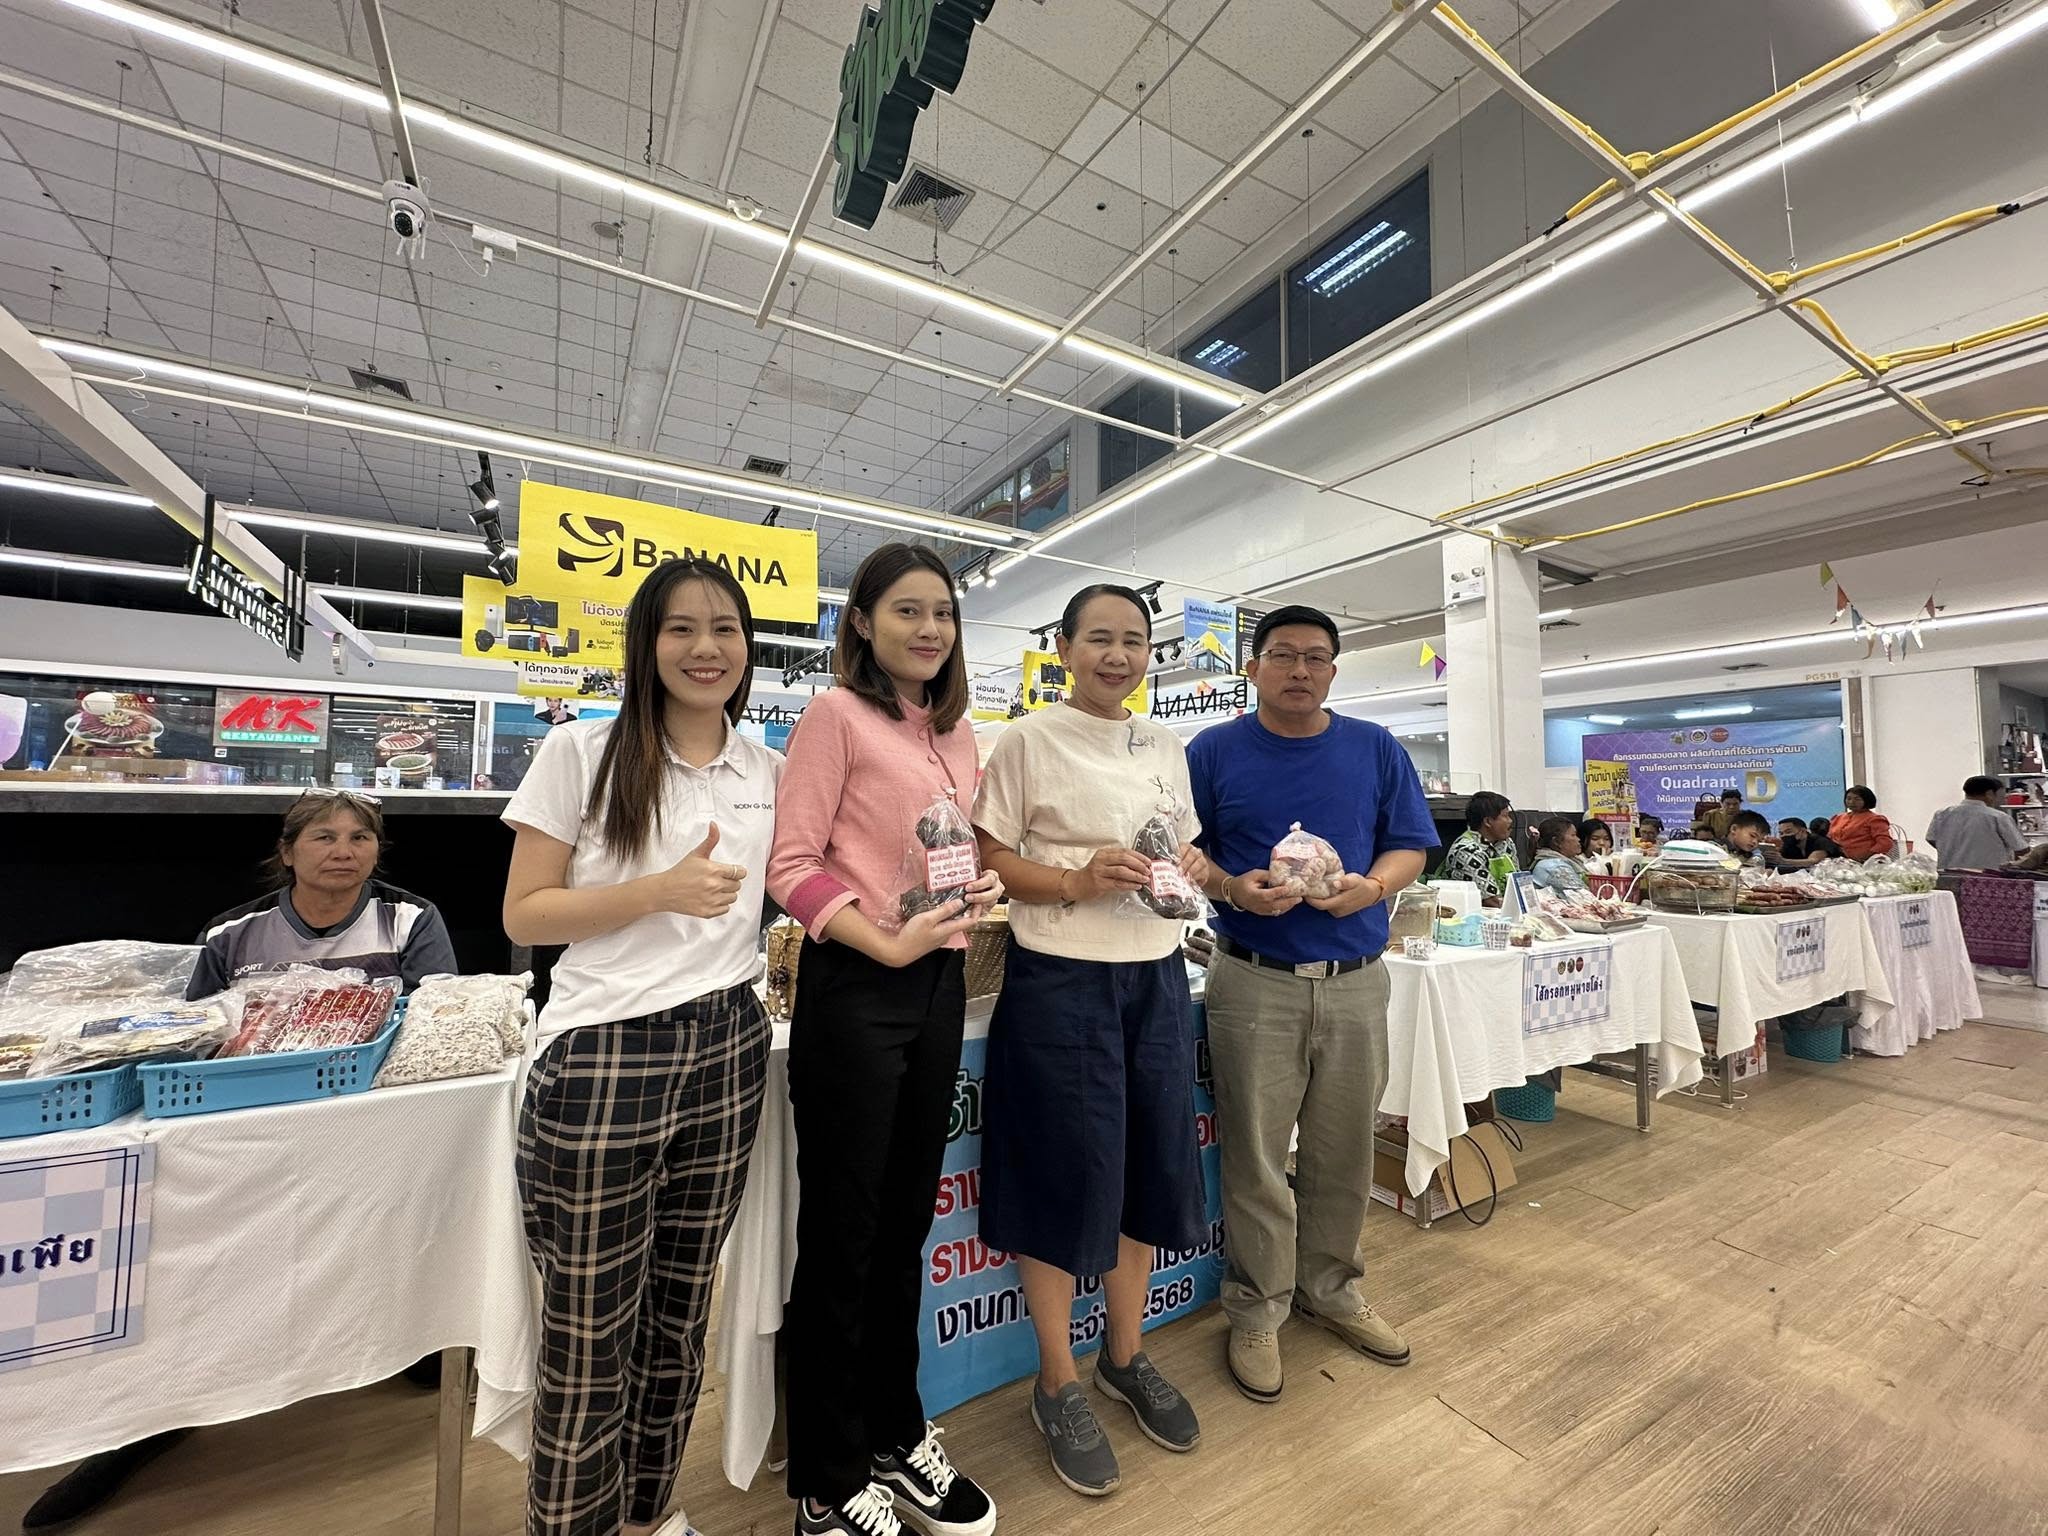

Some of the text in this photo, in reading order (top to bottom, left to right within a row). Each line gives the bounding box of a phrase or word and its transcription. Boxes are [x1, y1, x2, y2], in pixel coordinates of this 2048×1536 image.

[582, 600, 632, 617] ไม่ต้อง
[524, 661, 579, 675] ได้ทุกอาชีพ
[221, 695, 323, 732] MK
[221, 730, 321, 744] RESTAURANTS
[1660, 776, 1738, 791] Quadrant
